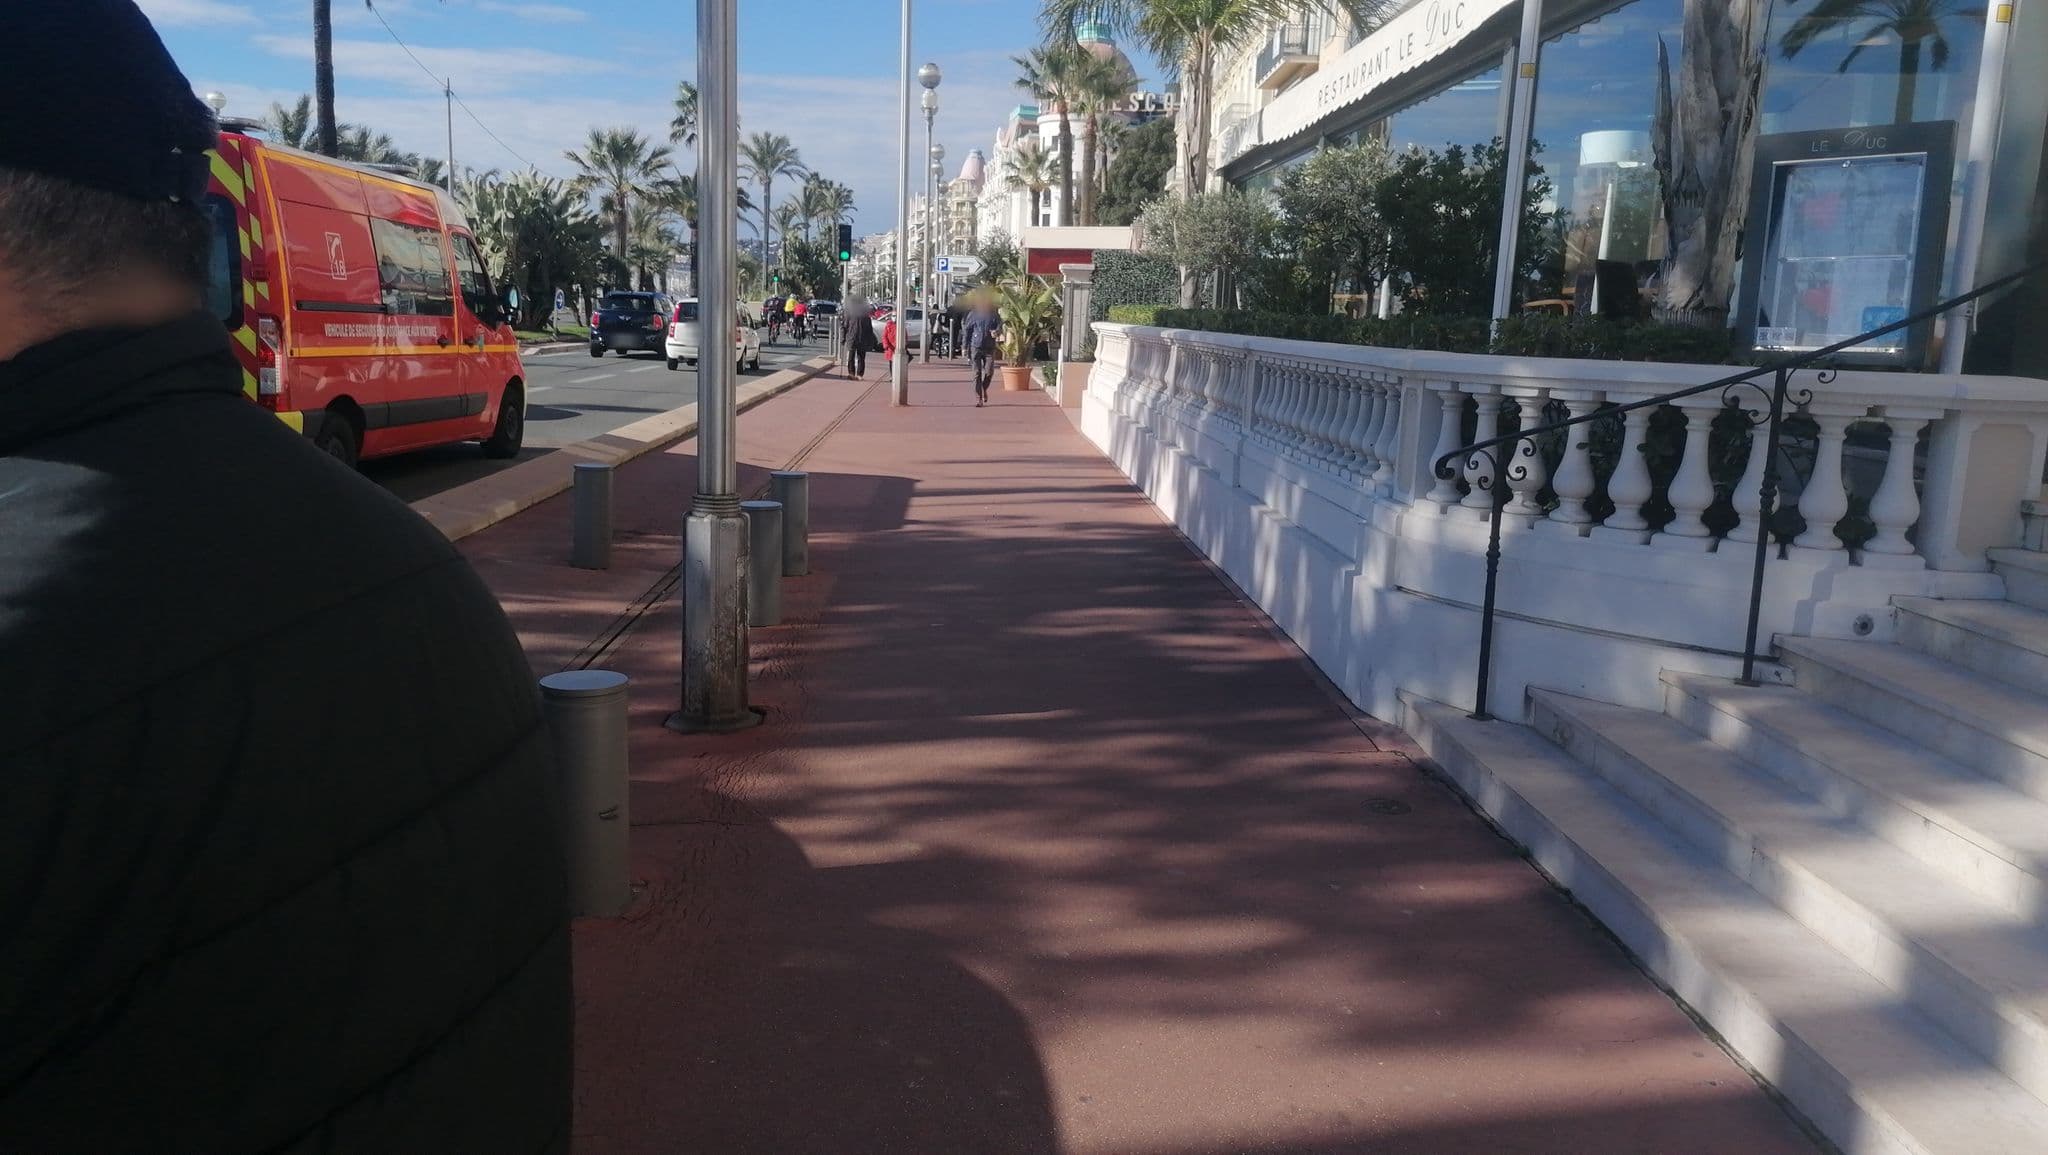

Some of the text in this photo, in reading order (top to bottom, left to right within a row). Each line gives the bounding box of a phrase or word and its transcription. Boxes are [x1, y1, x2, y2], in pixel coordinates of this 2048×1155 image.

[1318, 0, 1465, 107] RESTAURANT LE DUC
[1811, 130, 1887, 152] LE DUC
[335, 260, 346, 276] 18
